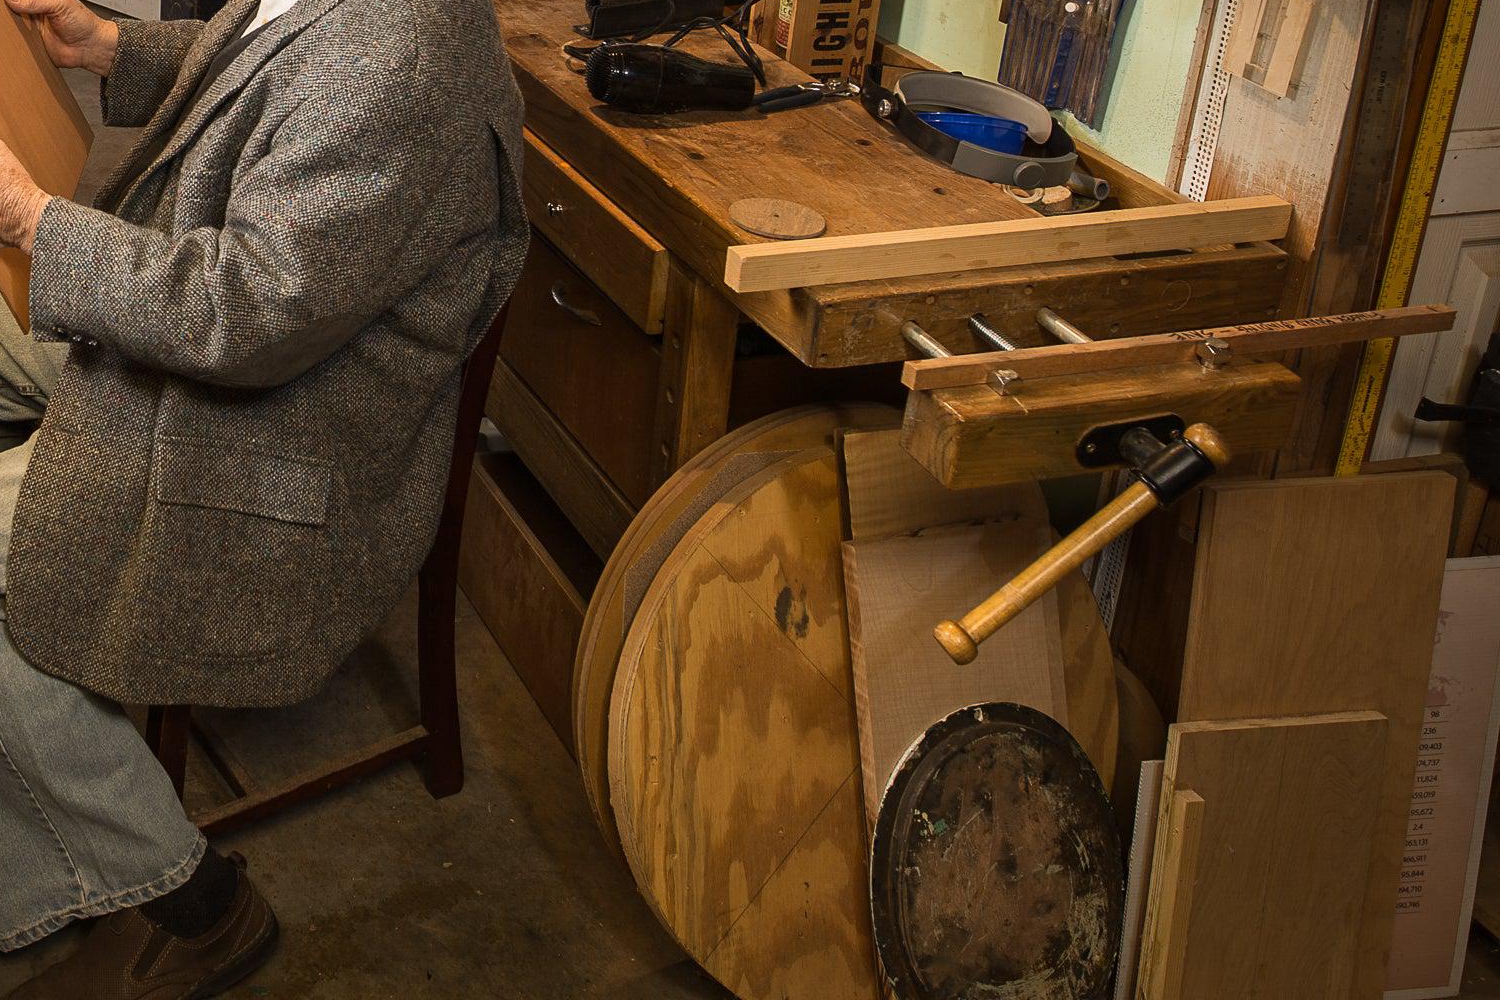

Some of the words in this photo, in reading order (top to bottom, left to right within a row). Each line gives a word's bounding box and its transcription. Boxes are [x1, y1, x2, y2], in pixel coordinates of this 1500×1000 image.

[1430, 710, 1440, 718] 98
[1423, 727, 1437, 735] 236
[1419, 742, 1442, 751] 09,403
[1410, 808, 1434, 817] 95,672
[1401, 870, 1425, 878] 95,844
